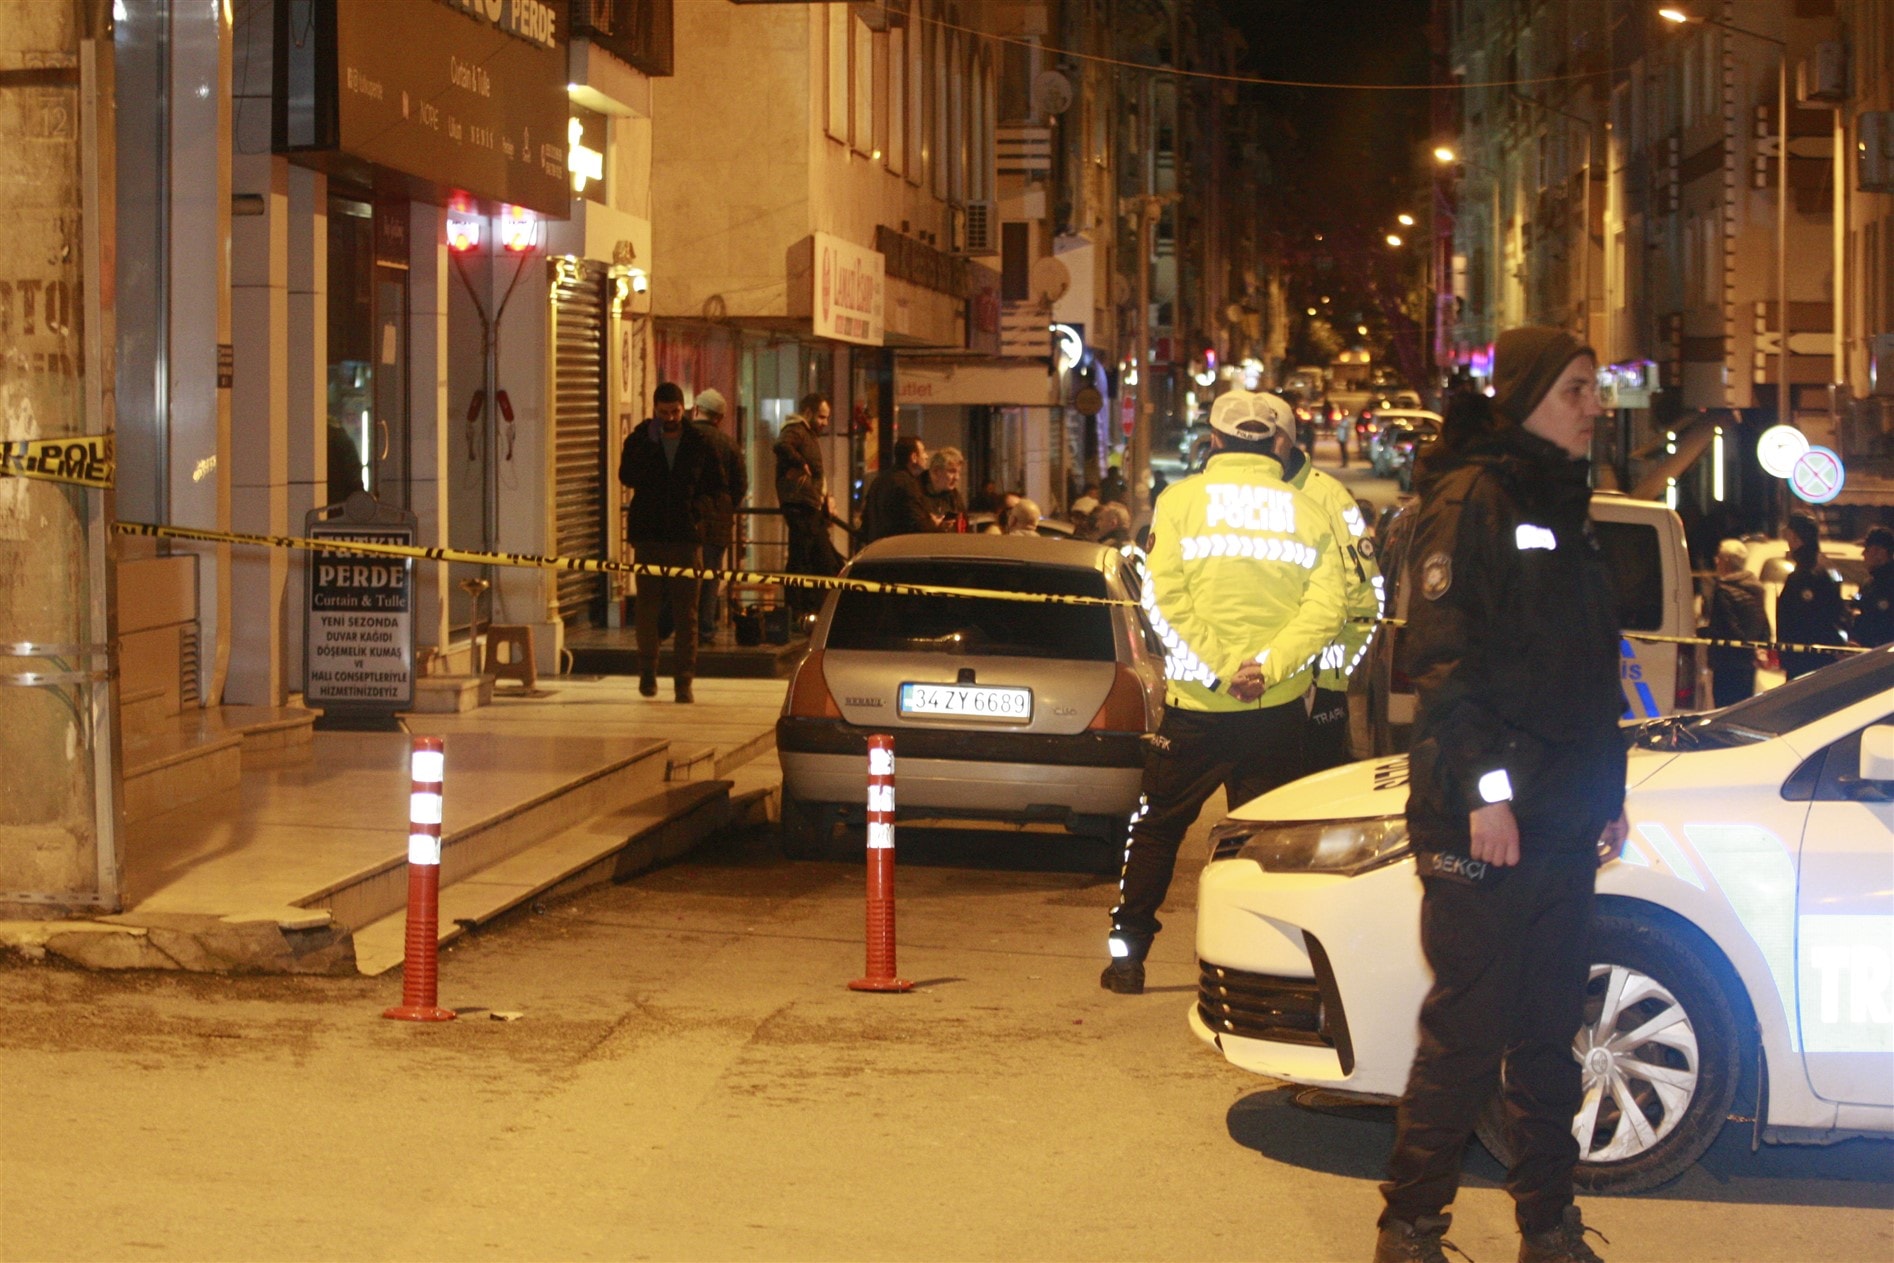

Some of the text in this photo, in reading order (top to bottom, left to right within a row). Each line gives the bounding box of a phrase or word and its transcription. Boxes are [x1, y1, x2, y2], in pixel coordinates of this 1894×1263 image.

[510, 0, 556, 49] PERDE
[318, 564, 404, 588] PERDE
[314, 593, 405, 608] Curtain & Tulle
[321, 615, 399, 628] YENİ SEZONDA
[326, 630, 393, 643] DUVAR KAĞIDI
[369, 647, 402, 660] KUMAŞ
[354, 660, 363, 669] VE
[916, 688, 1025, 714] 34 ZY 6689
